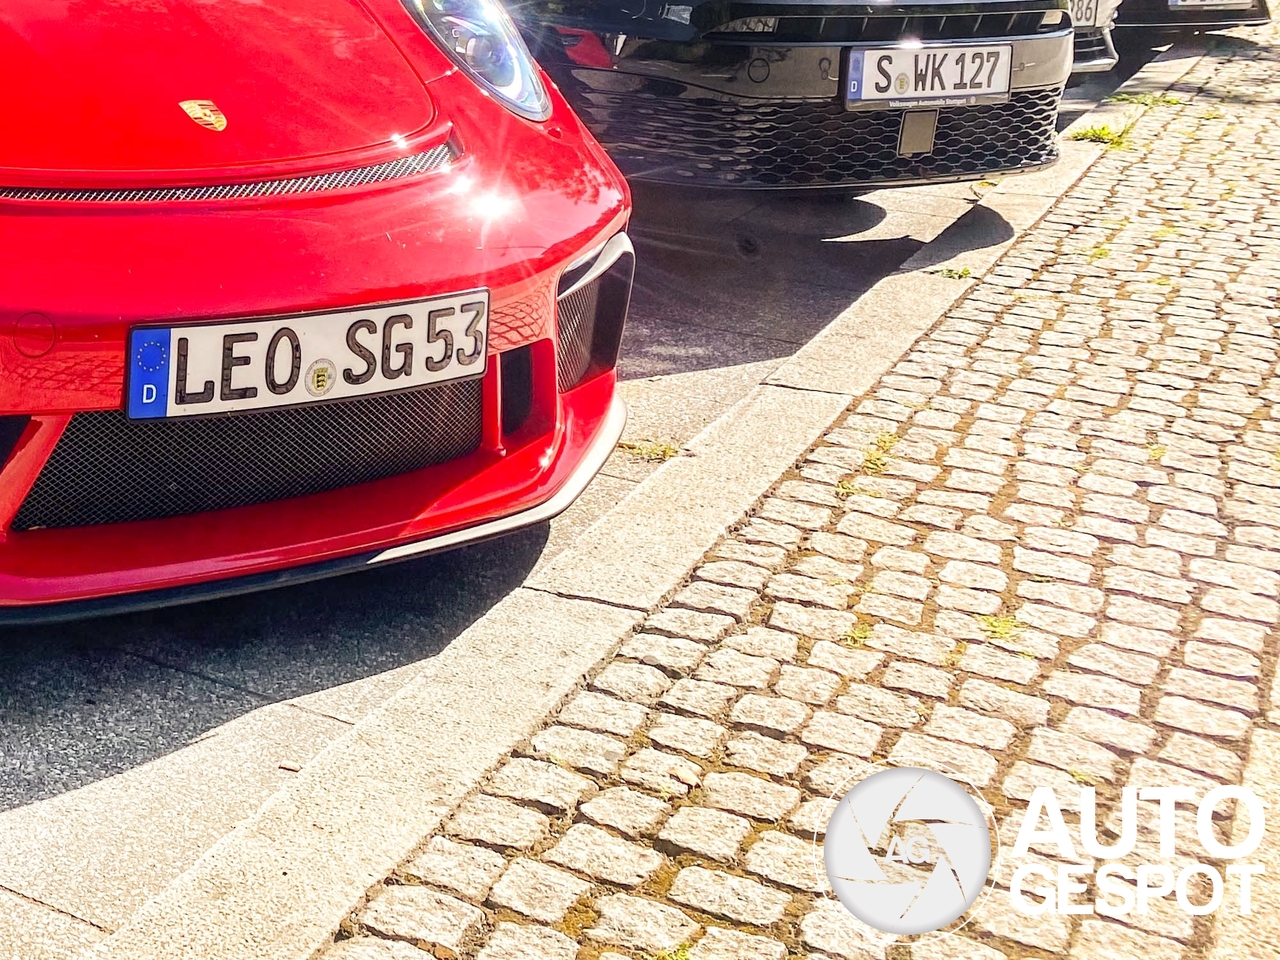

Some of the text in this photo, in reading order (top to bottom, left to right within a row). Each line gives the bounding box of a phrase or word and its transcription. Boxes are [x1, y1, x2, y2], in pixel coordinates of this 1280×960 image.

[851, 81, 858, 92] D
[875, 51, 1000, 93] S WK 127
[174, 301, 486, 406] LEO SG 53
[142, 384, 157, 404] D
